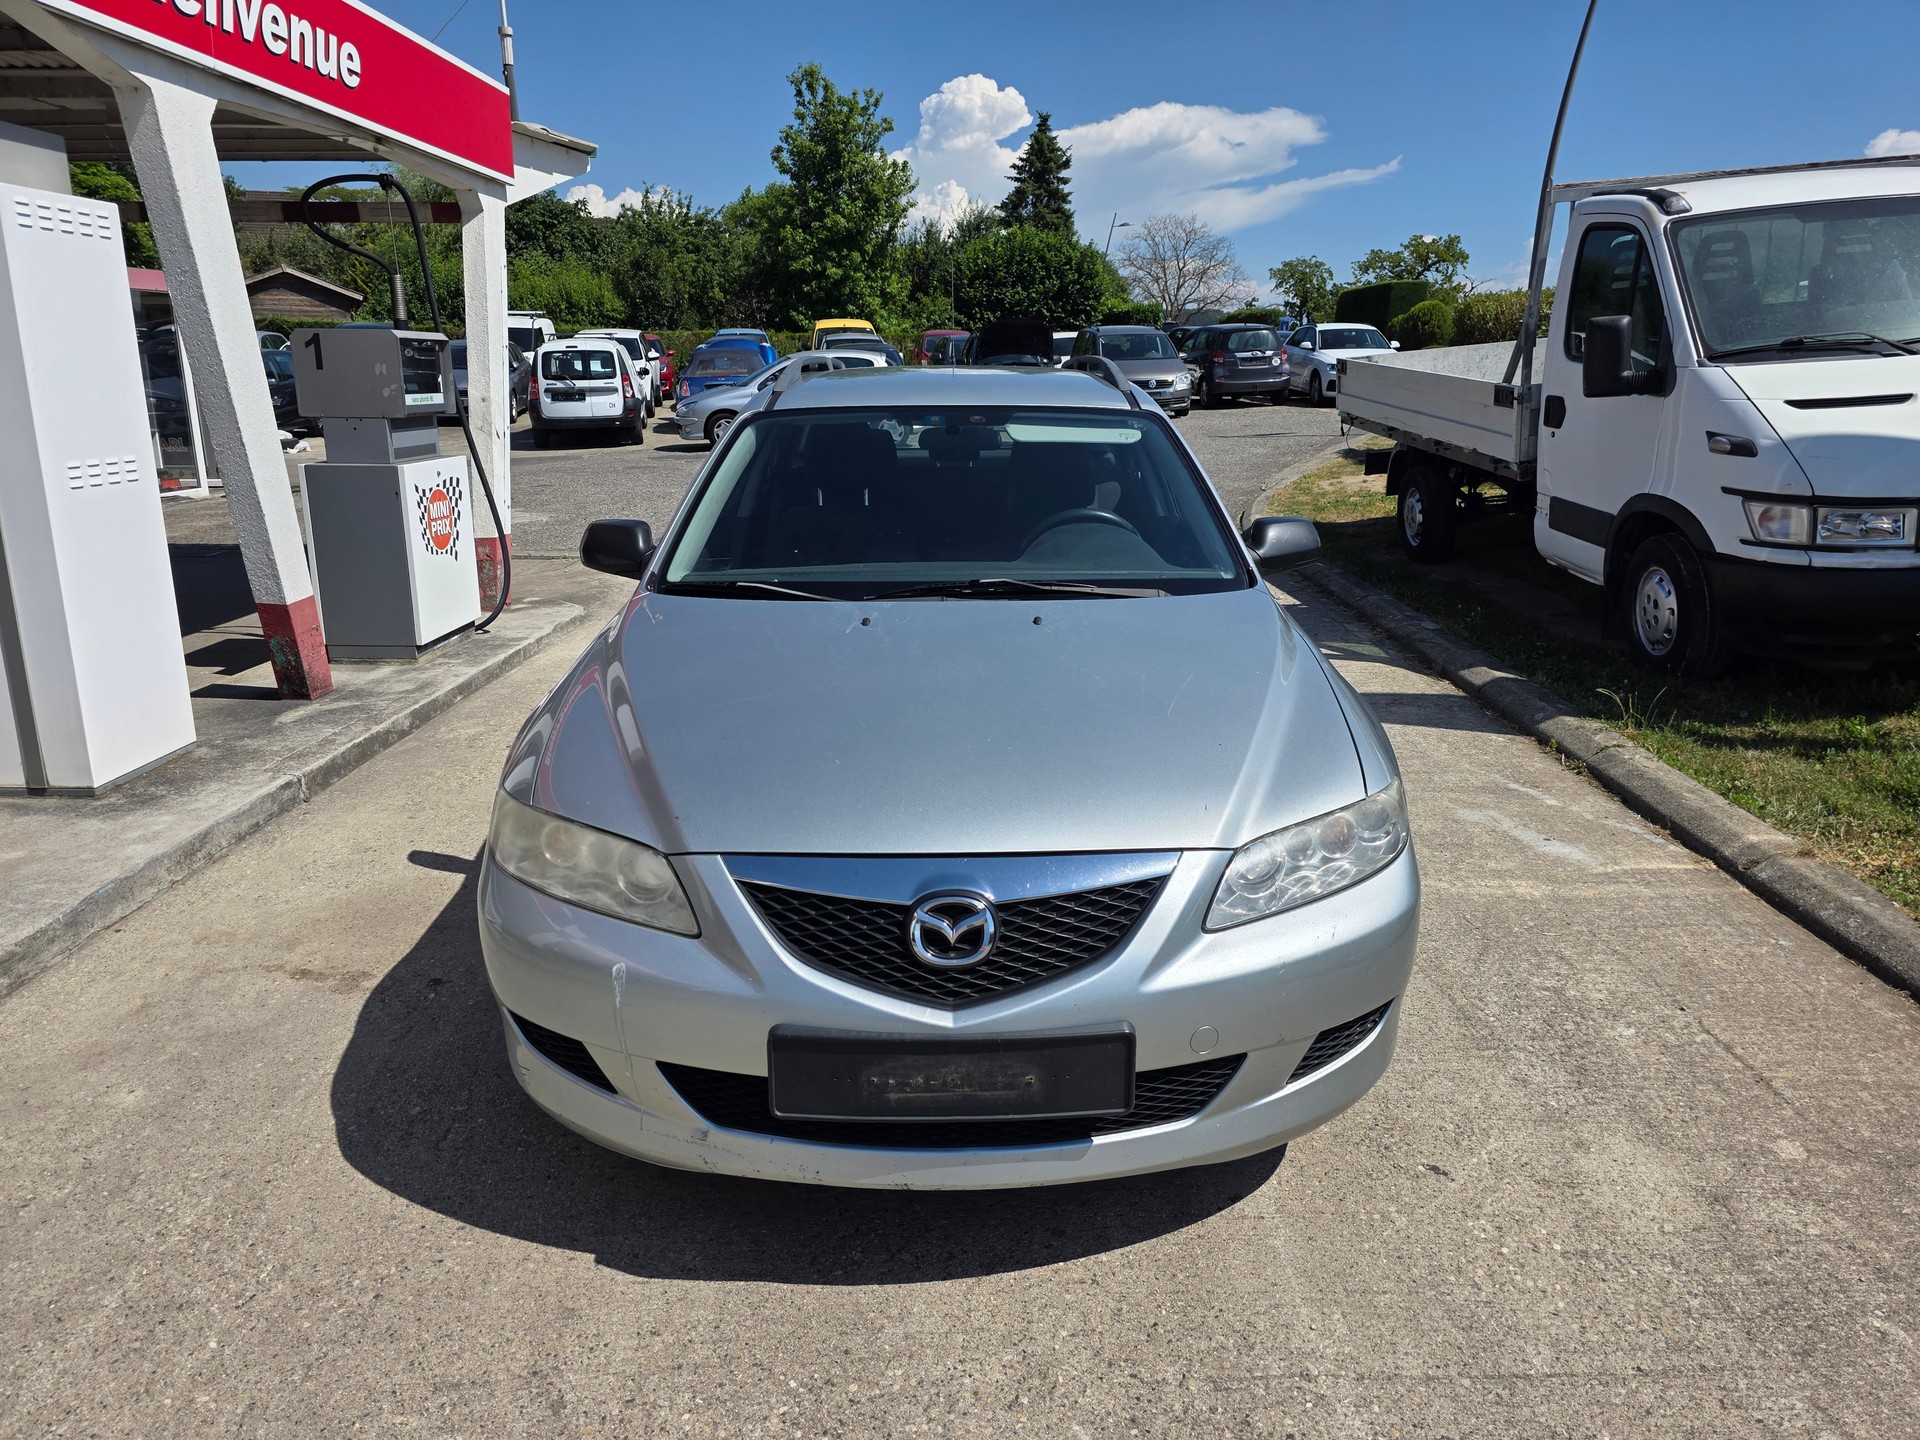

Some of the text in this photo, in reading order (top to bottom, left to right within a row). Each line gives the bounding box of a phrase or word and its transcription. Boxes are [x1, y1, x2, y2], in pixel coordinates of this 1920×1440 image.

[152, 0, 361, 89] nvenue
[305, 333, 323, 370] 1
[430, 500, 450, 519] MINI
[432, 518, 452, 537] PRIX
